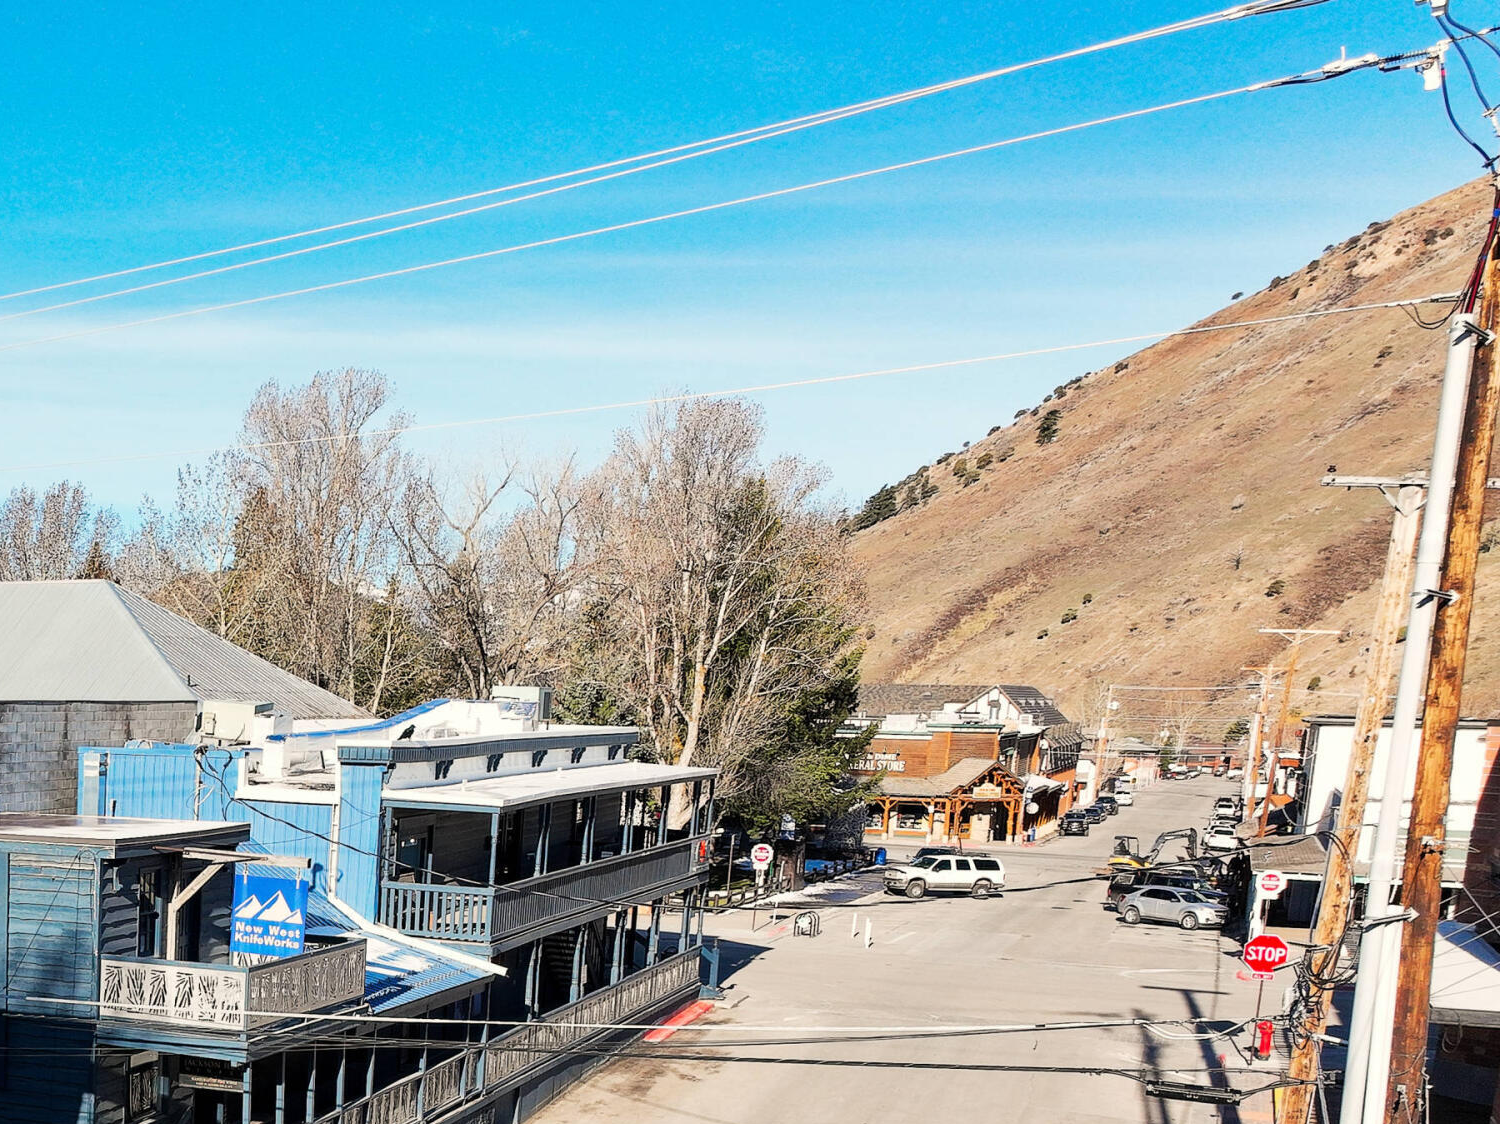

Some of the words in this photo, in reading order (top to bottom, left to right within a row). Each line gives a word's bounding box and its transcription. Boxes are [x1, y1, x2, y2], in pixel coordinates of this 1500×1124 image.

[877, 760, 906, 771] STORE
[235, 922, 264, 934] New
[268, 925, 301, 938] West
[234, 932, 300, 949] KnifeWorks
[1246, 946, 1286, 962] STOP
